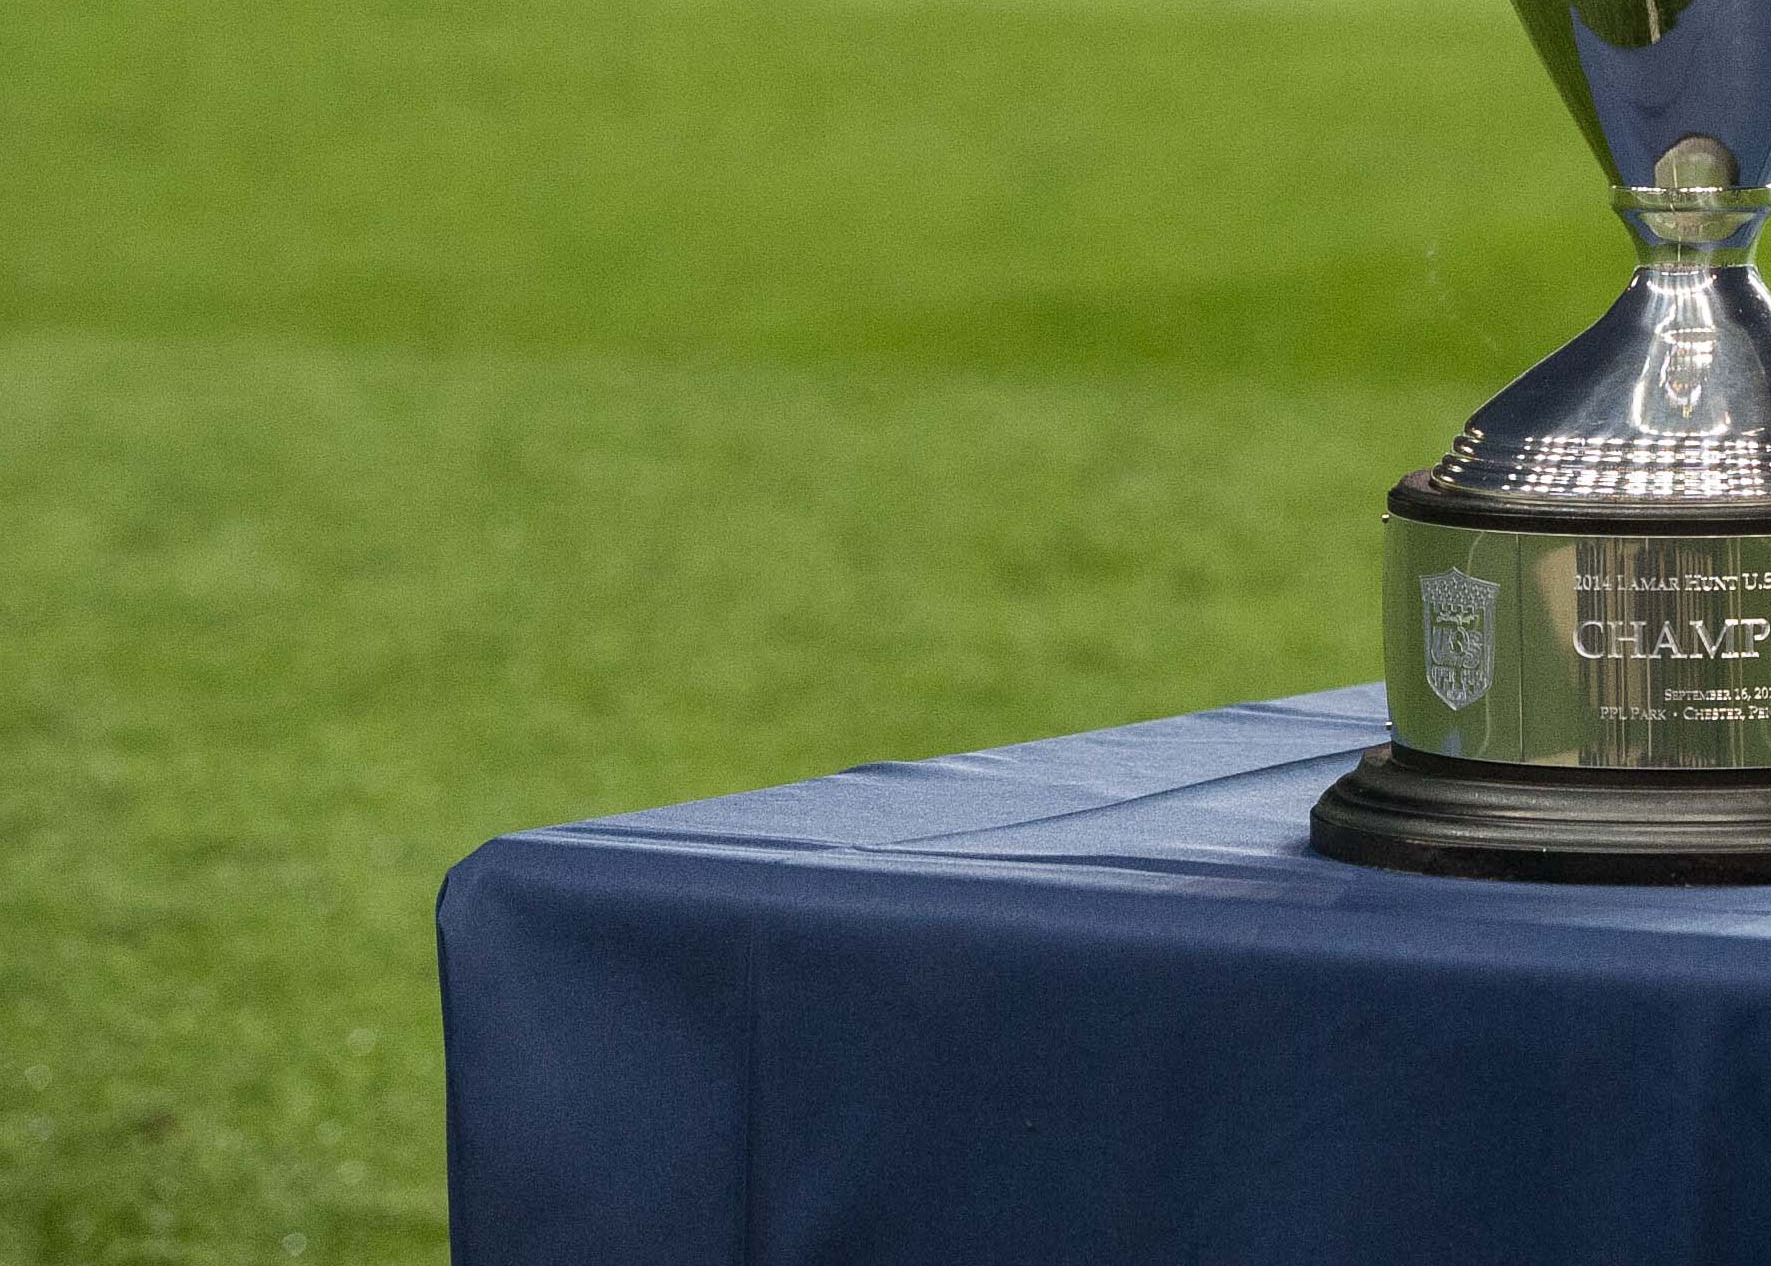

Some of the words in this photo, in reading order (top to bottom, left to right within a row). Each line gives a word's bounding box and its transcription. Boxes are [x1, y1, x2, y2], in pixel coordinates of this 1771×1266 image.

[1573, 574, 1613, 591] 2014
[1616, 574, 1681, 591] LAMAR
[1684, 573, 1738, 592] HUNT
[1734, 686, 1752, 702] 16,
